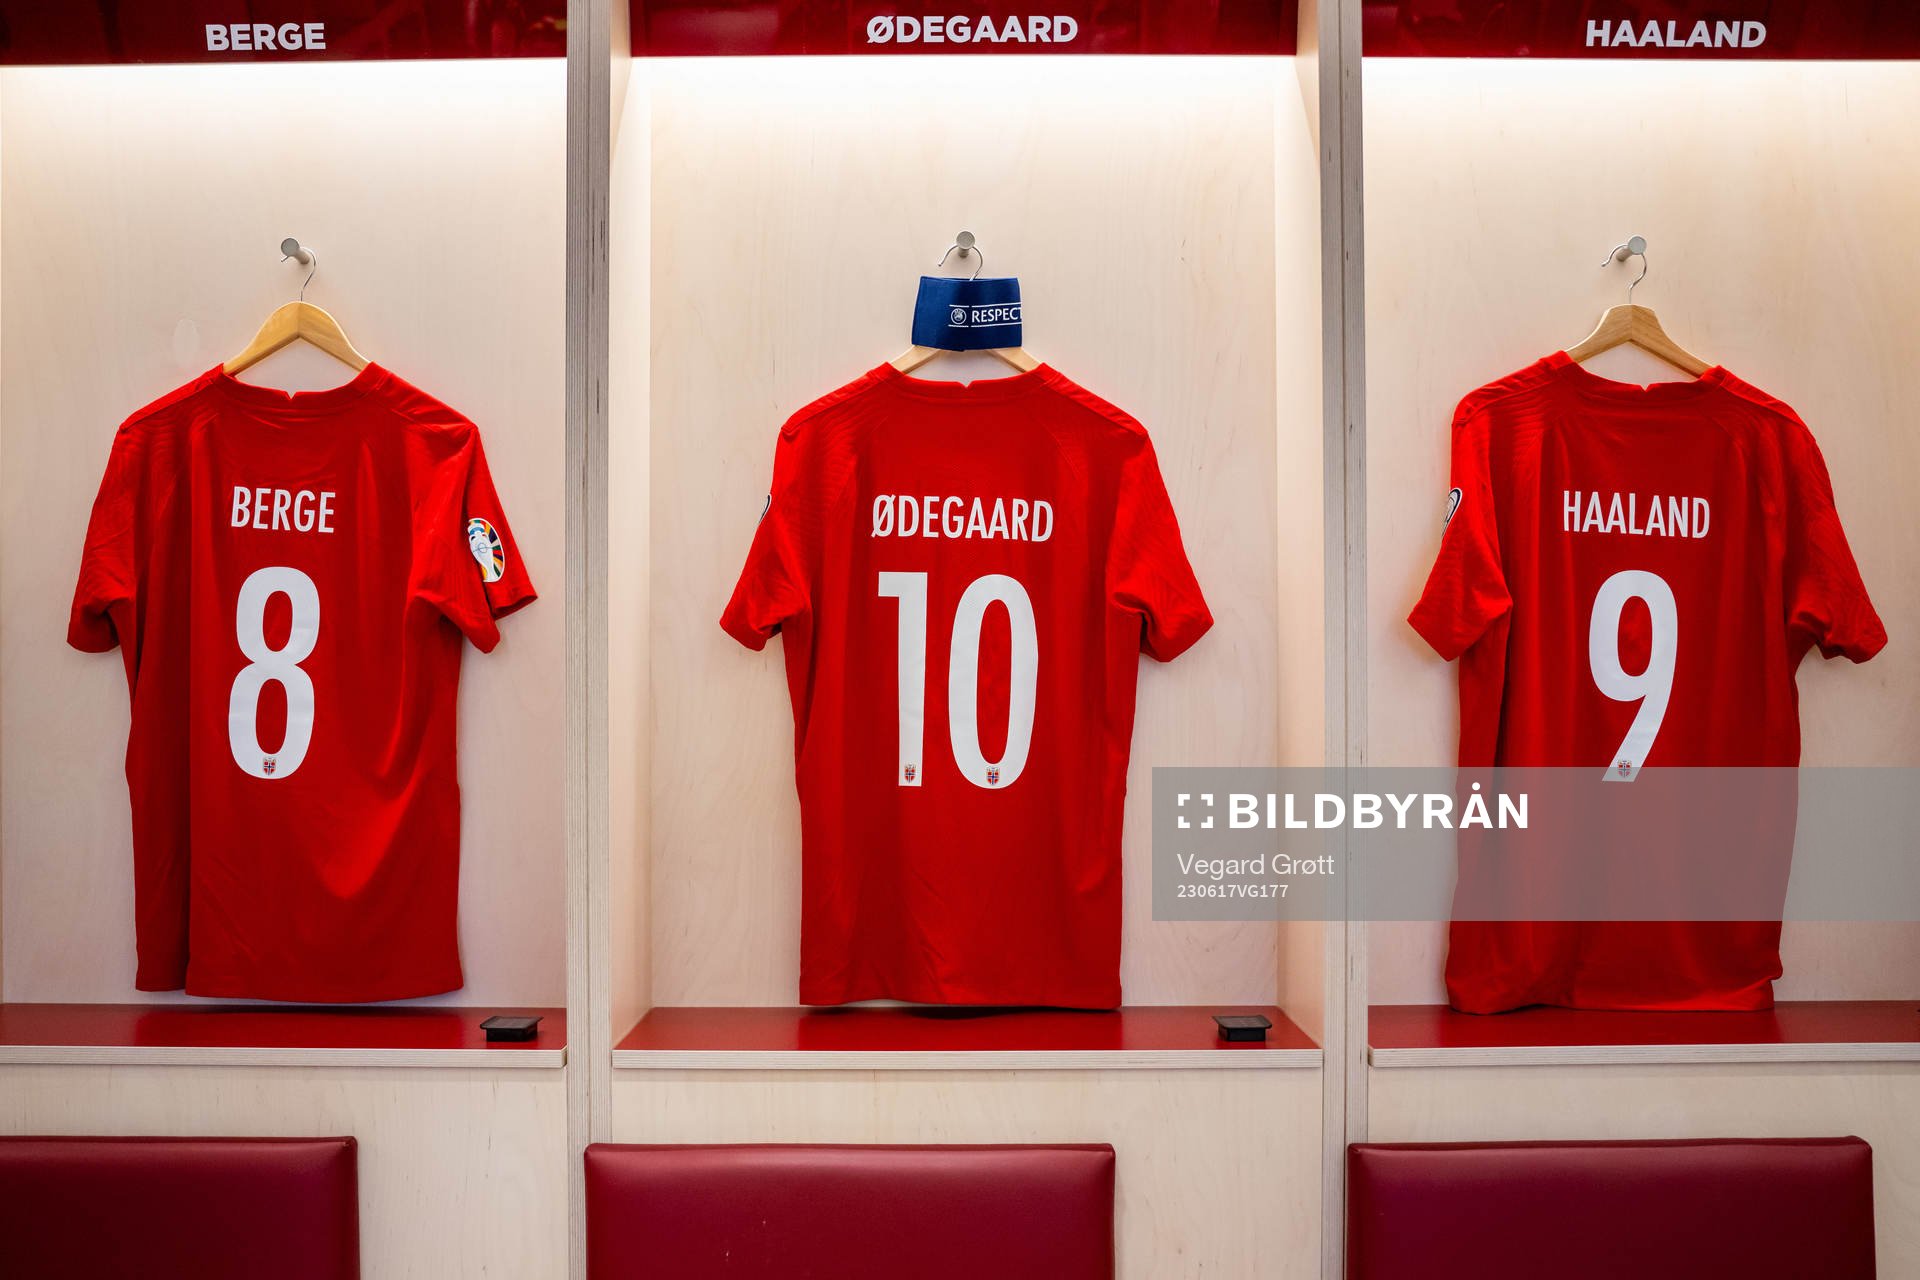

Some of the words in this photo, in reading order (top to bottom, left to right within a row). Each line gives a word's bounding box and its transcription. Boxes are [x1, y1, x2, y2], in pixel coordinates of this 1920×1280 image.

[206, 22, 326, 51] BERGE
[867, 15, 1077, 44] ØDEGAARD
[1586, 19, 1766, 48] HAALAND
[231, 486, 336, 534] BERGE
[871, 494, 1054, 542] ØDEGAARD
[1563, 490, 1710, 539] HAALAND
[228, 566, 321, 780] 8
[877, 571, 1039, 789] 10
[1588, 569, 1678, 783] 9
